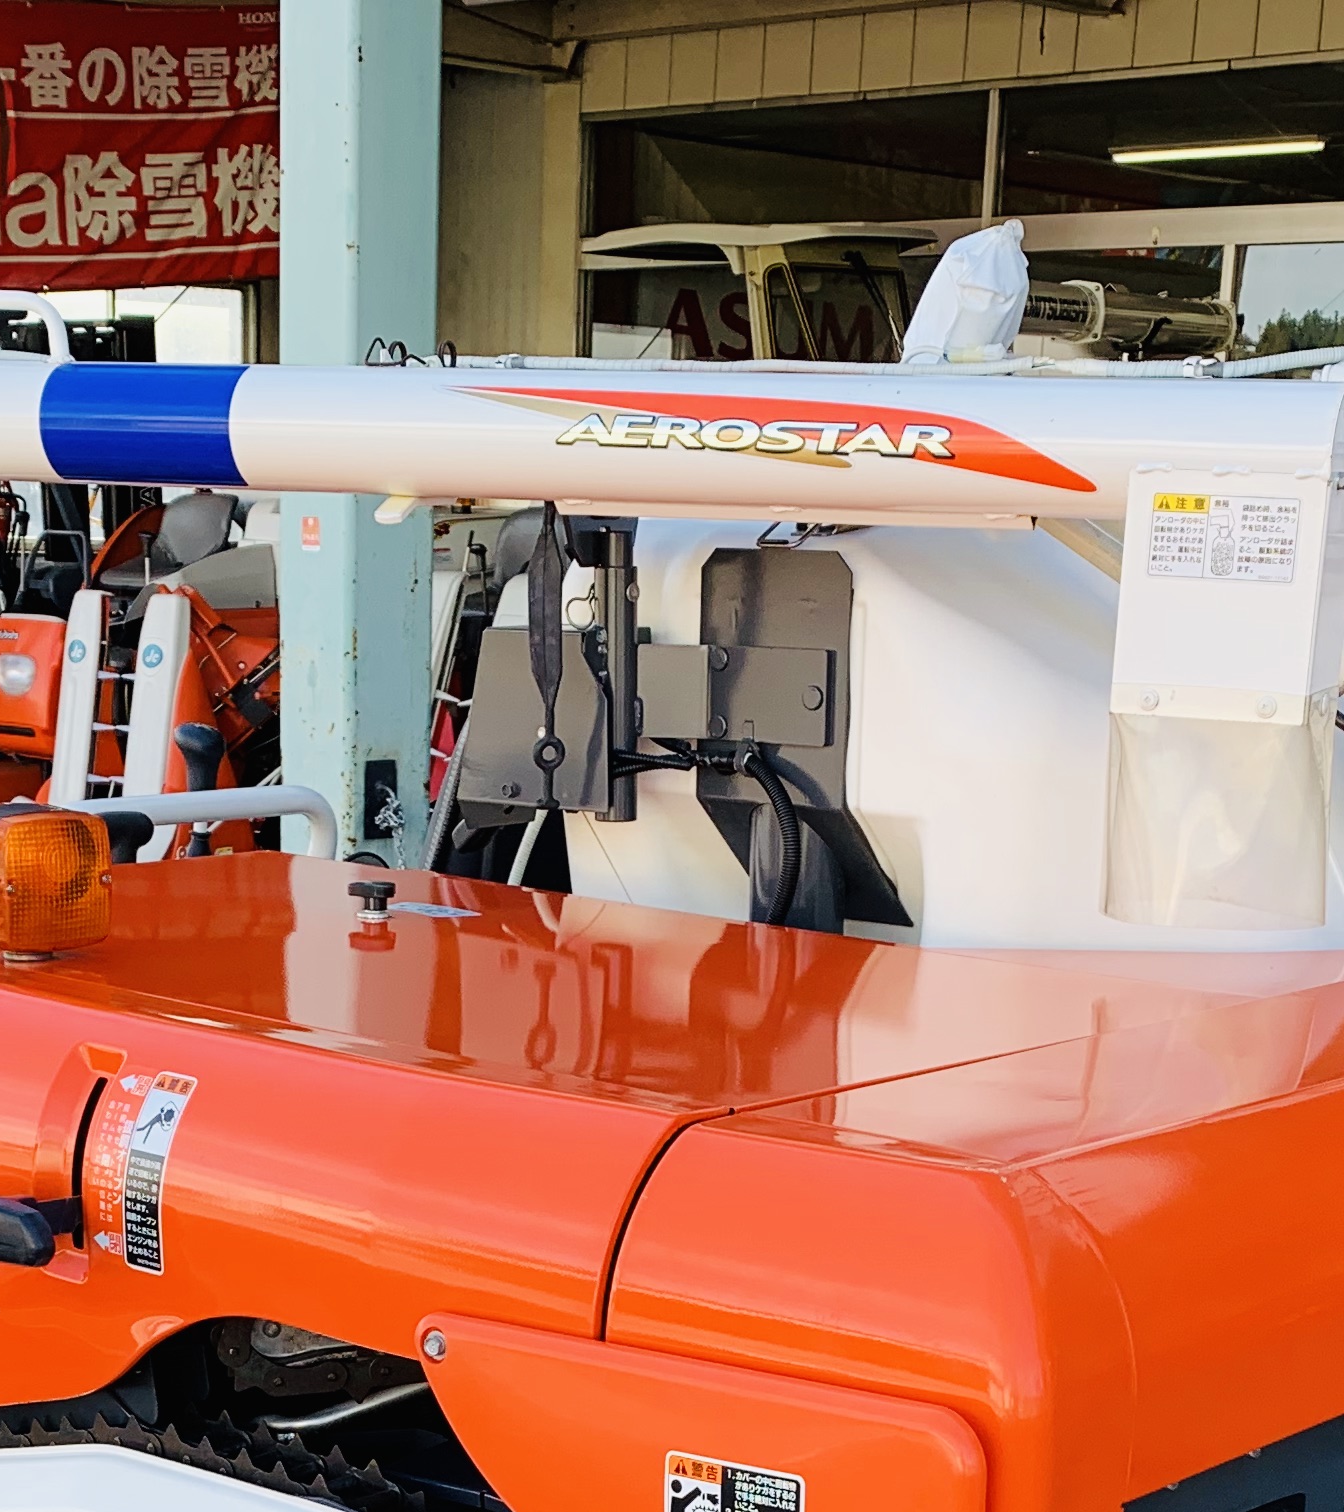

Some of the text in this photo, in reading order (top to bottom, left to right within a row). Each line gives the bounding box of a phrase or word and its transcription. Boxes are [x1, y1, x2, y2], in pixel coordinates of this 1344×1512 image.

[238, 11, 279, 24] HON
[556, 412, 956, 459] AEROSTAR
[1175, 496, 1207, 511] 注意
[691, 1461, 718, 1481] 警告
